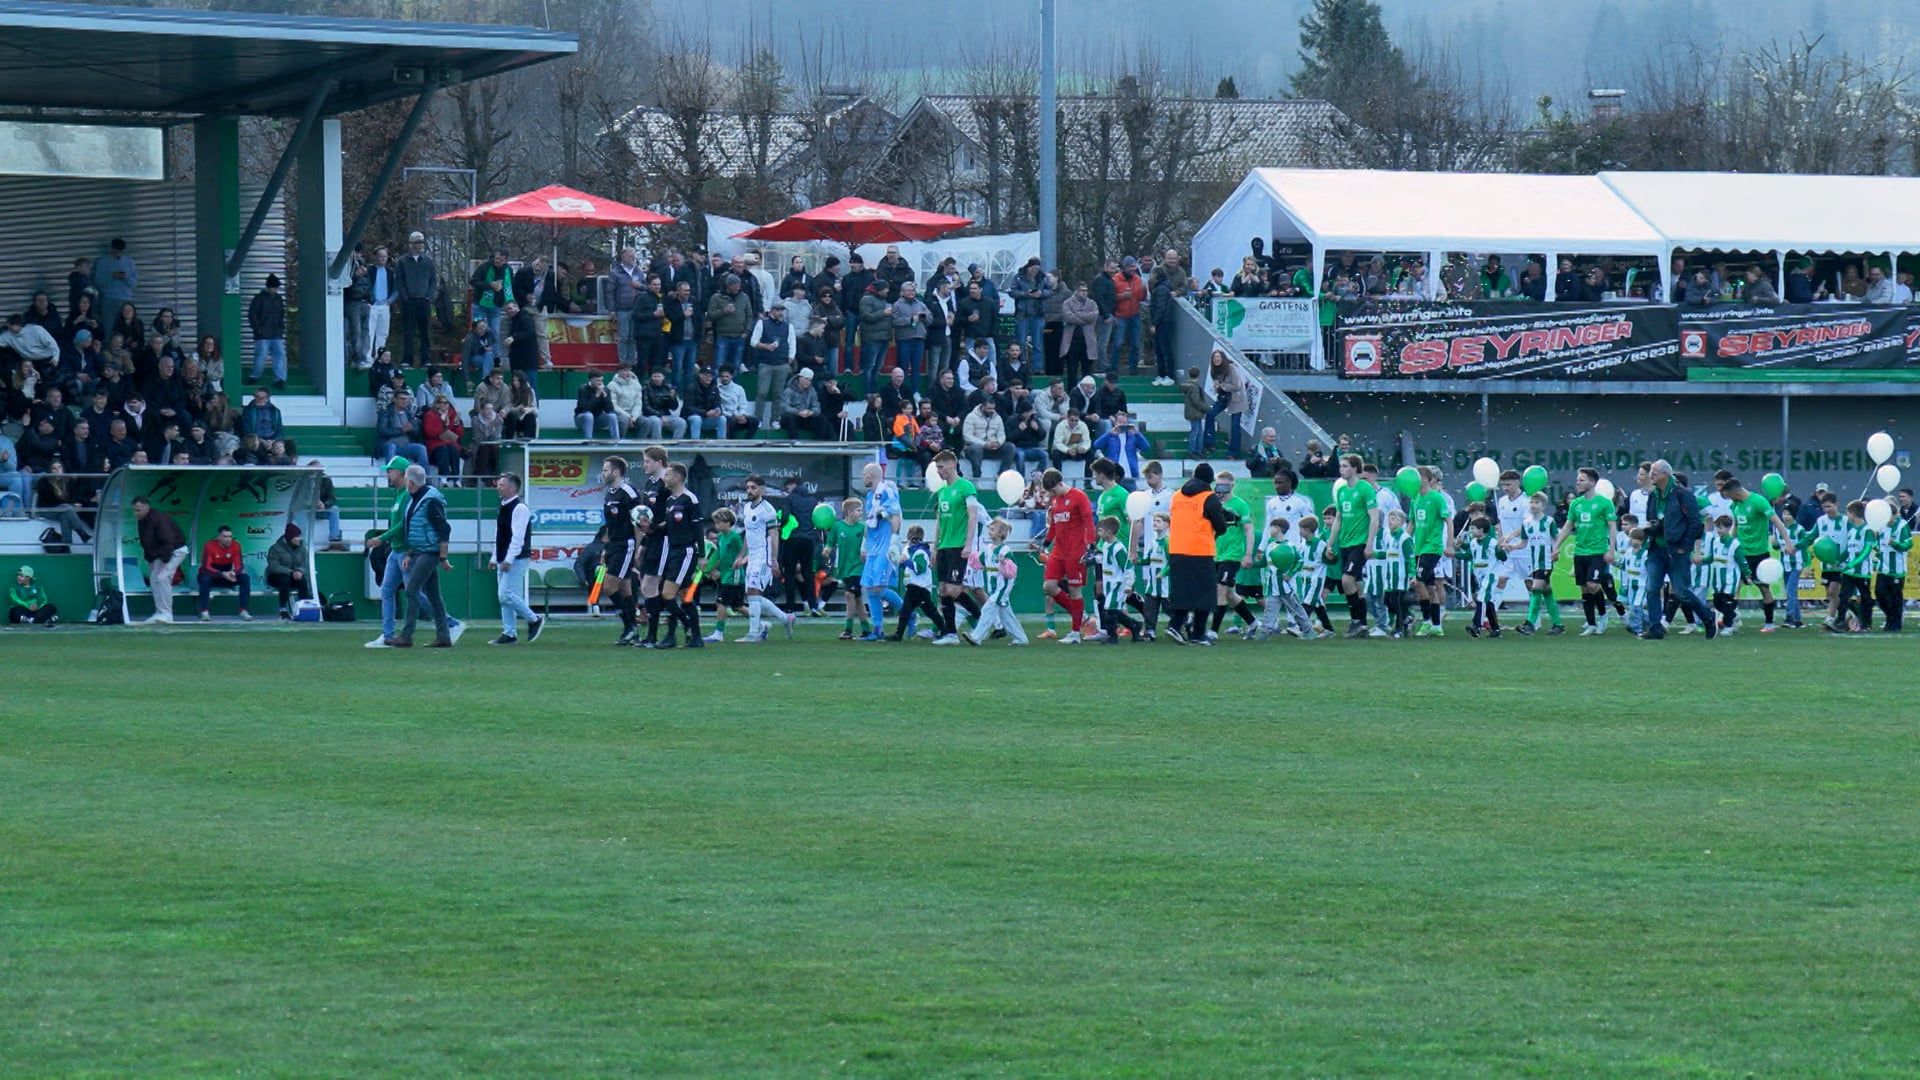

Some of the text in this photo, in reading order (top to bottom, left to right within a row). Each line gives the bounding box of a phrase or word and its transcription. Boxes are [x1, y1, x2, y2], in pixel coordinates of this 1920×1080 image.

[1399, 321, 1633, 374] SEYRINGER
[1717, 322, 1872, 357] SEYRINGER
[1508, 447, 1646, 471] GEMEINDE
